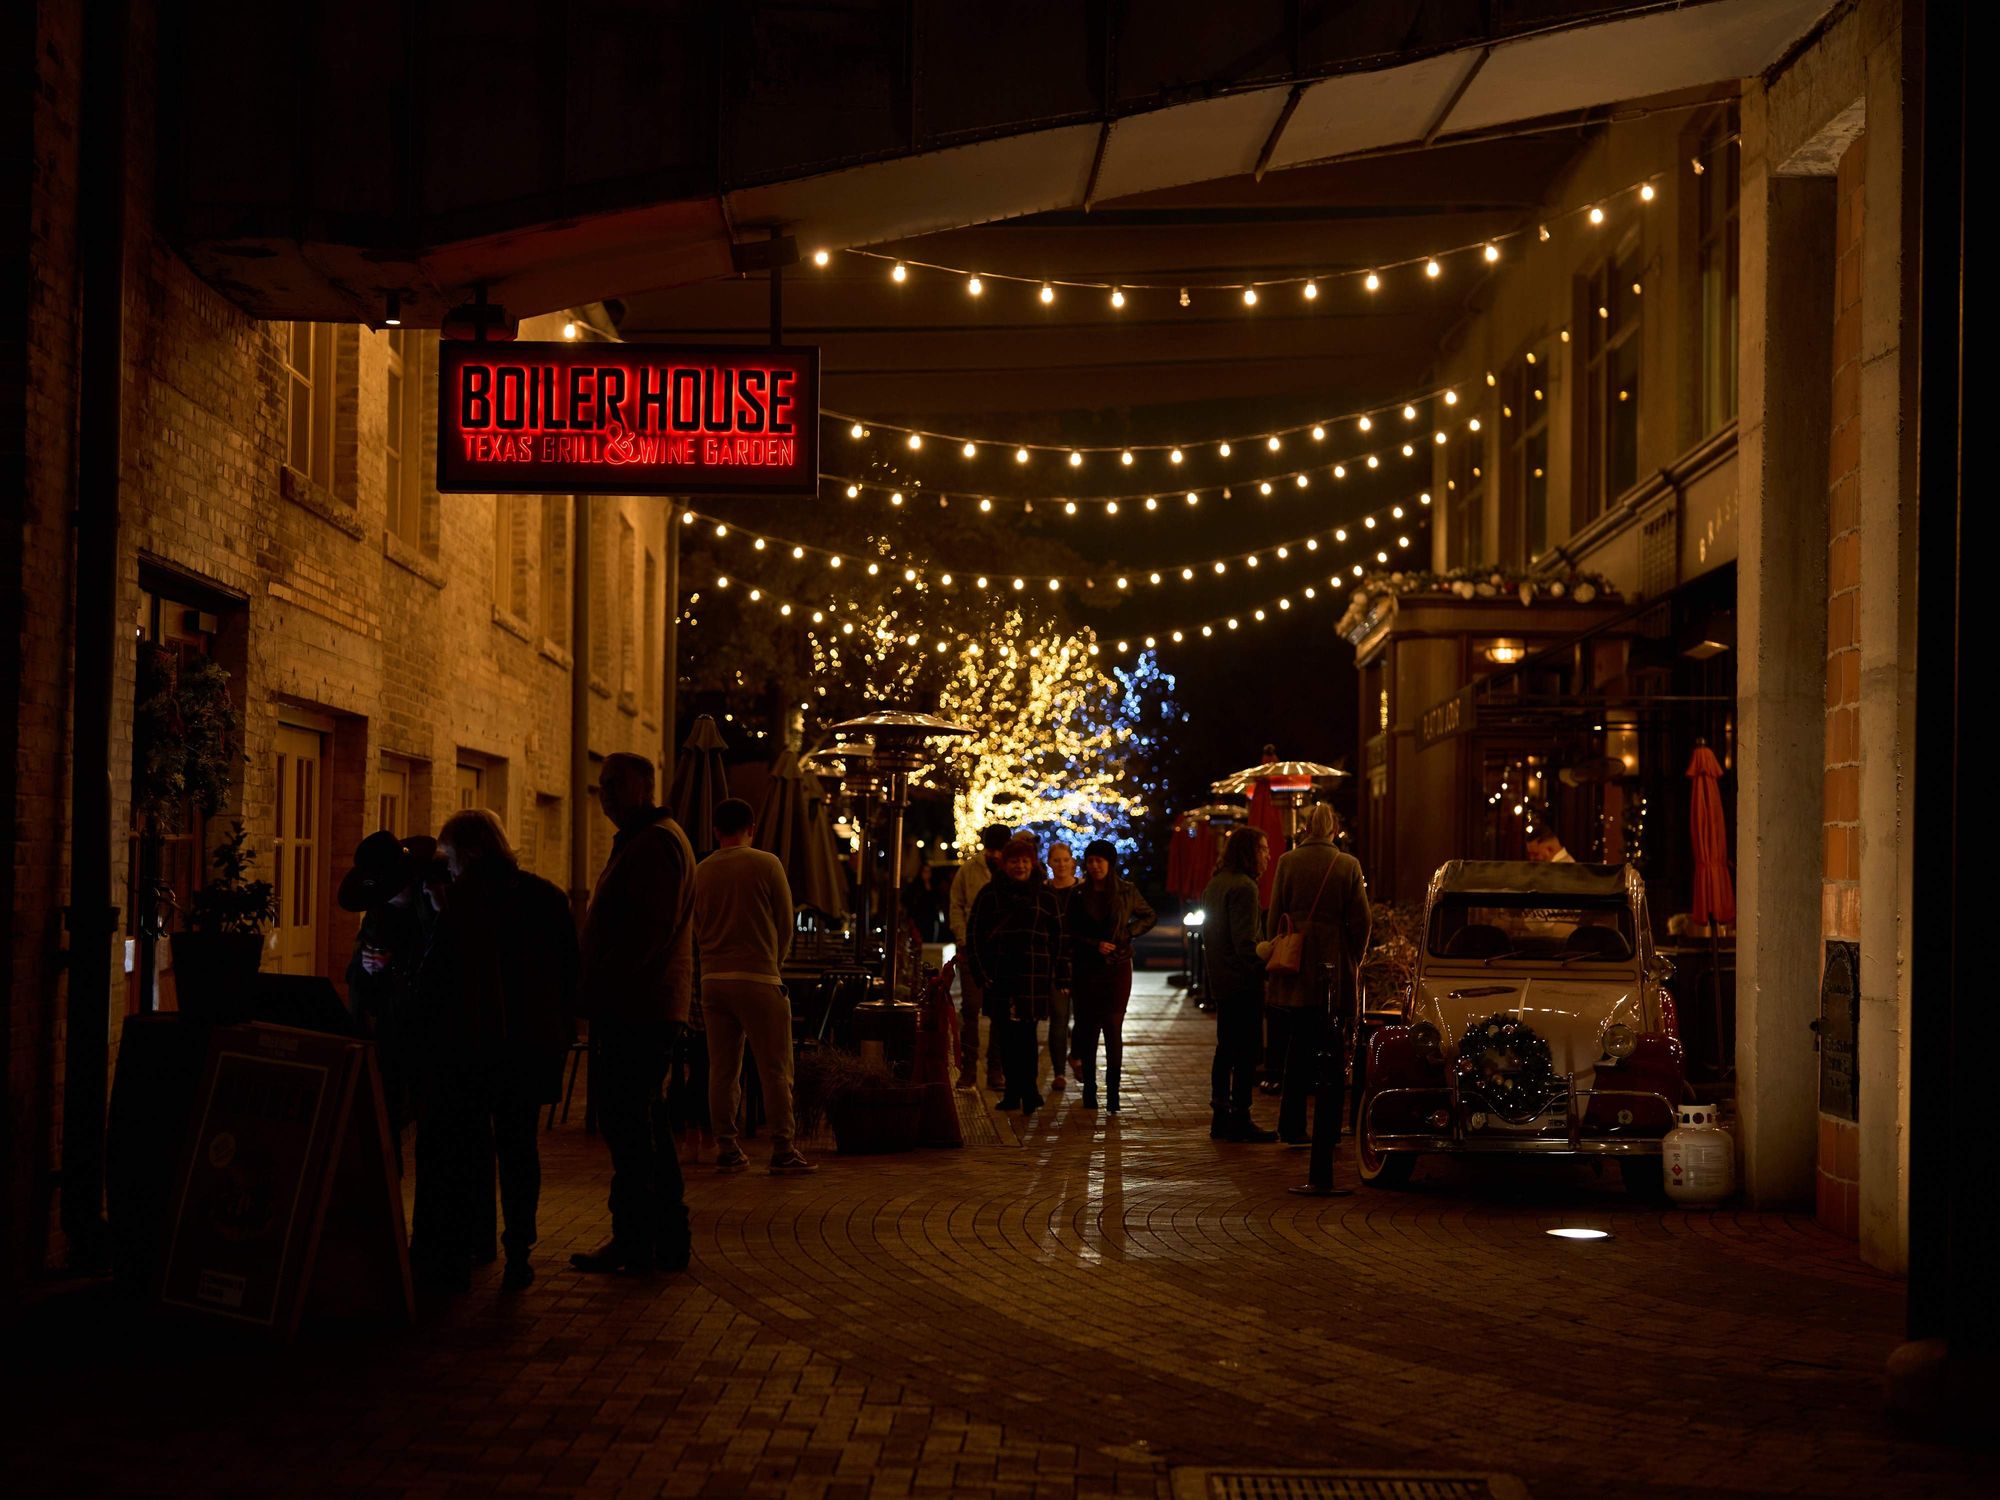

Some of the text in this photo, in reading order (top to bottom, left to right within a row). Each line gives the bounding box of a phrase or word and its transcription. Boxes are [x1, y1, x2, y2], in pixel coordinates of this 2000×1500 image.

[461, 366, 794, 434] BOILER HOUSE
[462, 422, 794, 467] TEXAS GRILL & WINE GARDEN
